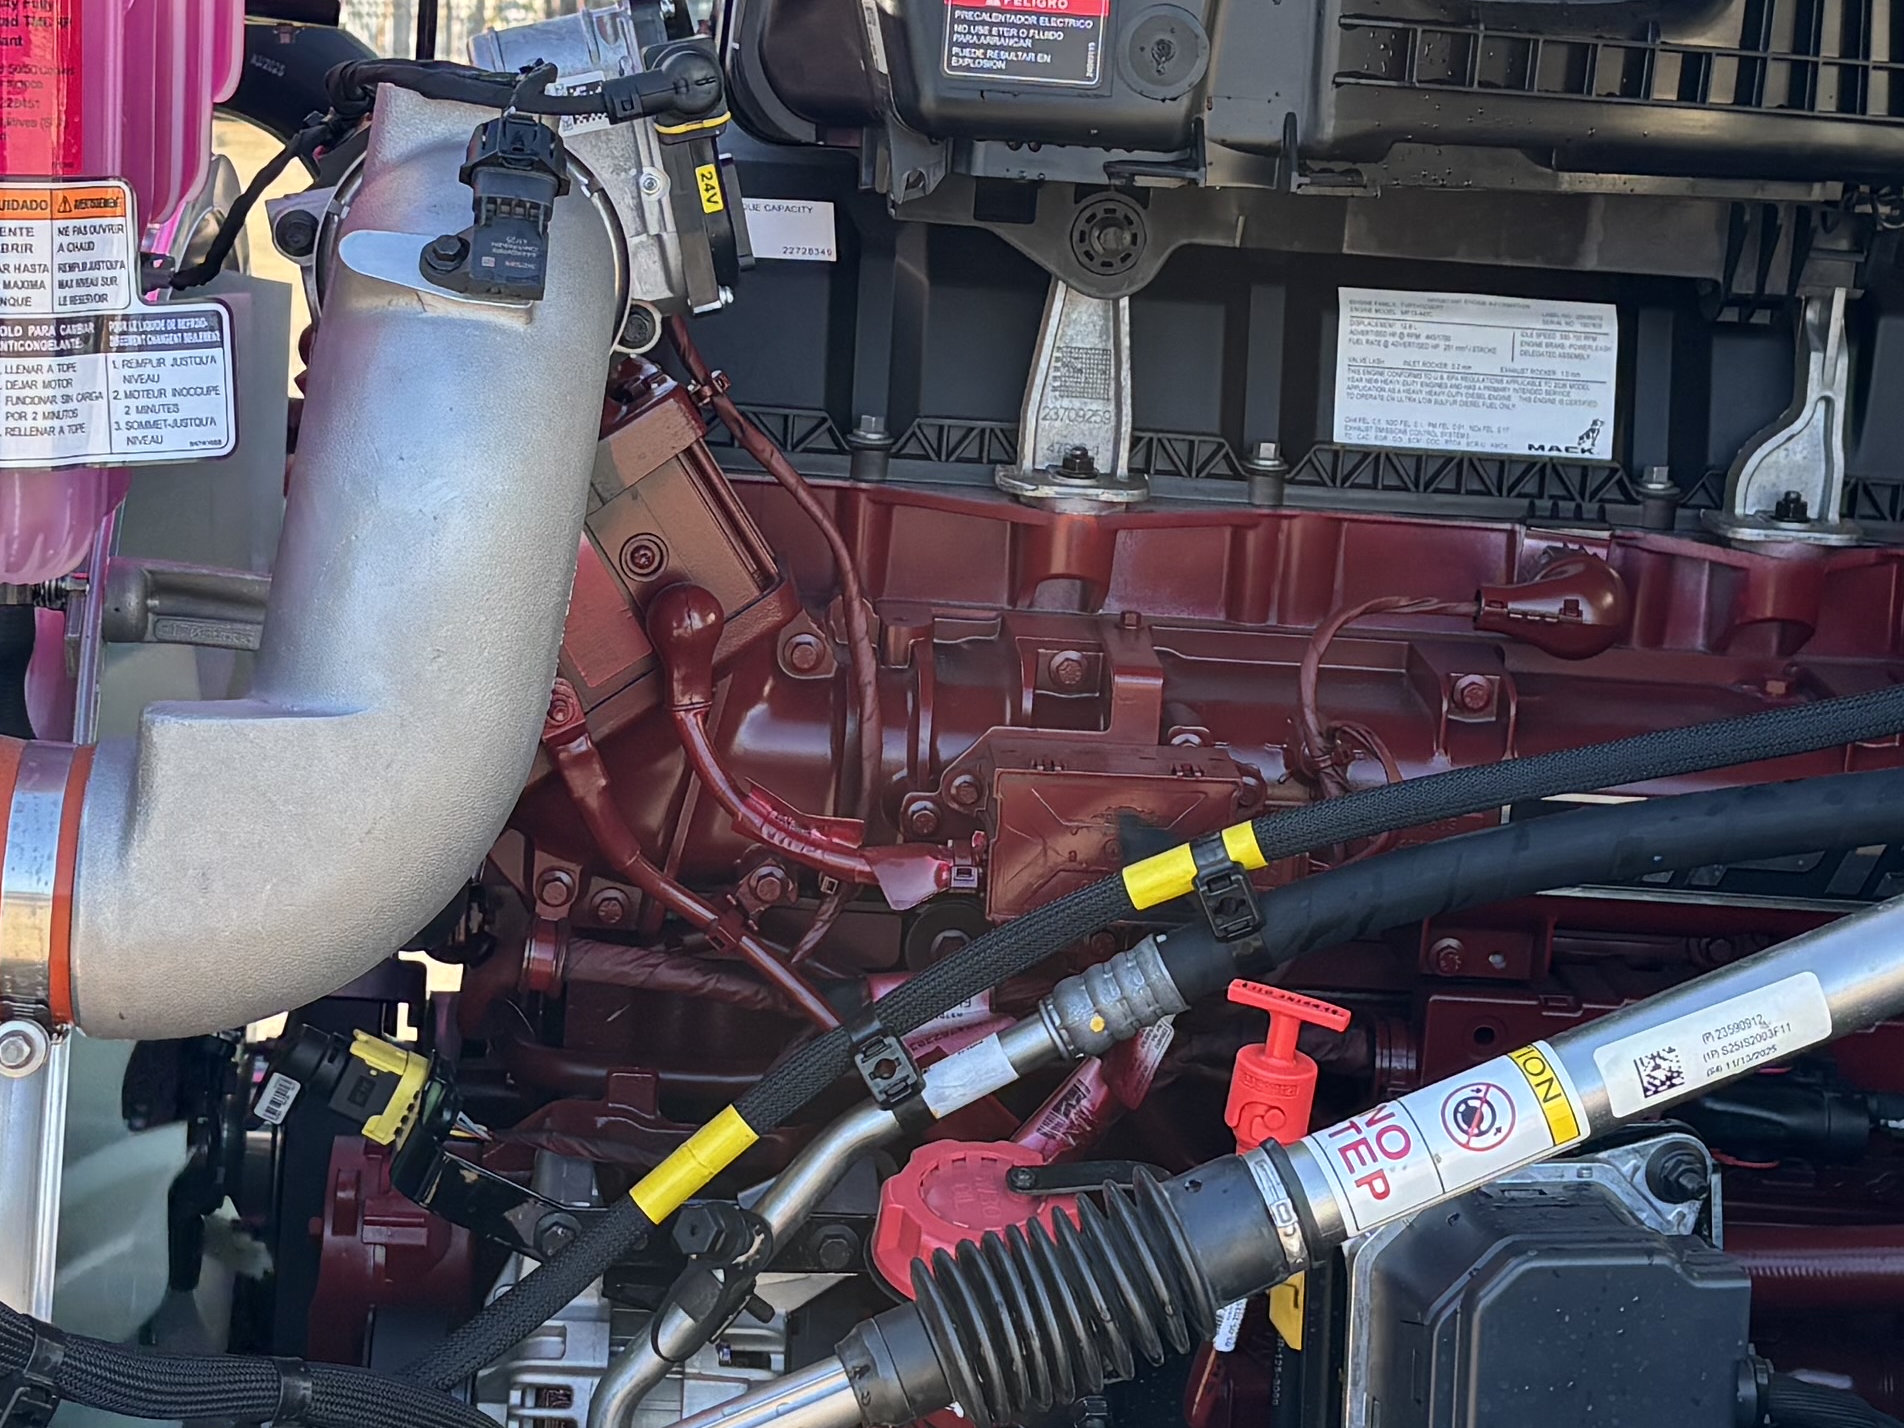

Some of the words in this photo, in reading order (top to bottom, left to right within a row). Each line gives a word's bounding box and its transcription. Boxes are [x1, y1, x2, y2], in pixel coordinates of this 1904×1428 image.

[951, 57, 1006, 70] EXPLOSION
[700, 171, 720, 205] 24V
[763, 203, 814, 215] CAPACITY
[13, 262, 49, 274] HASTA
[28, 324, 56, 337] PARA
[4, 363, 45, 375] LLENAR
[46, 363, 55, 373] A
[42, 378, 74, 390] MOTOR
[5, 409, 29, 422] POR
[32, 410, 39, 421] 2
[1527, 443, 1596, 456] MACK
